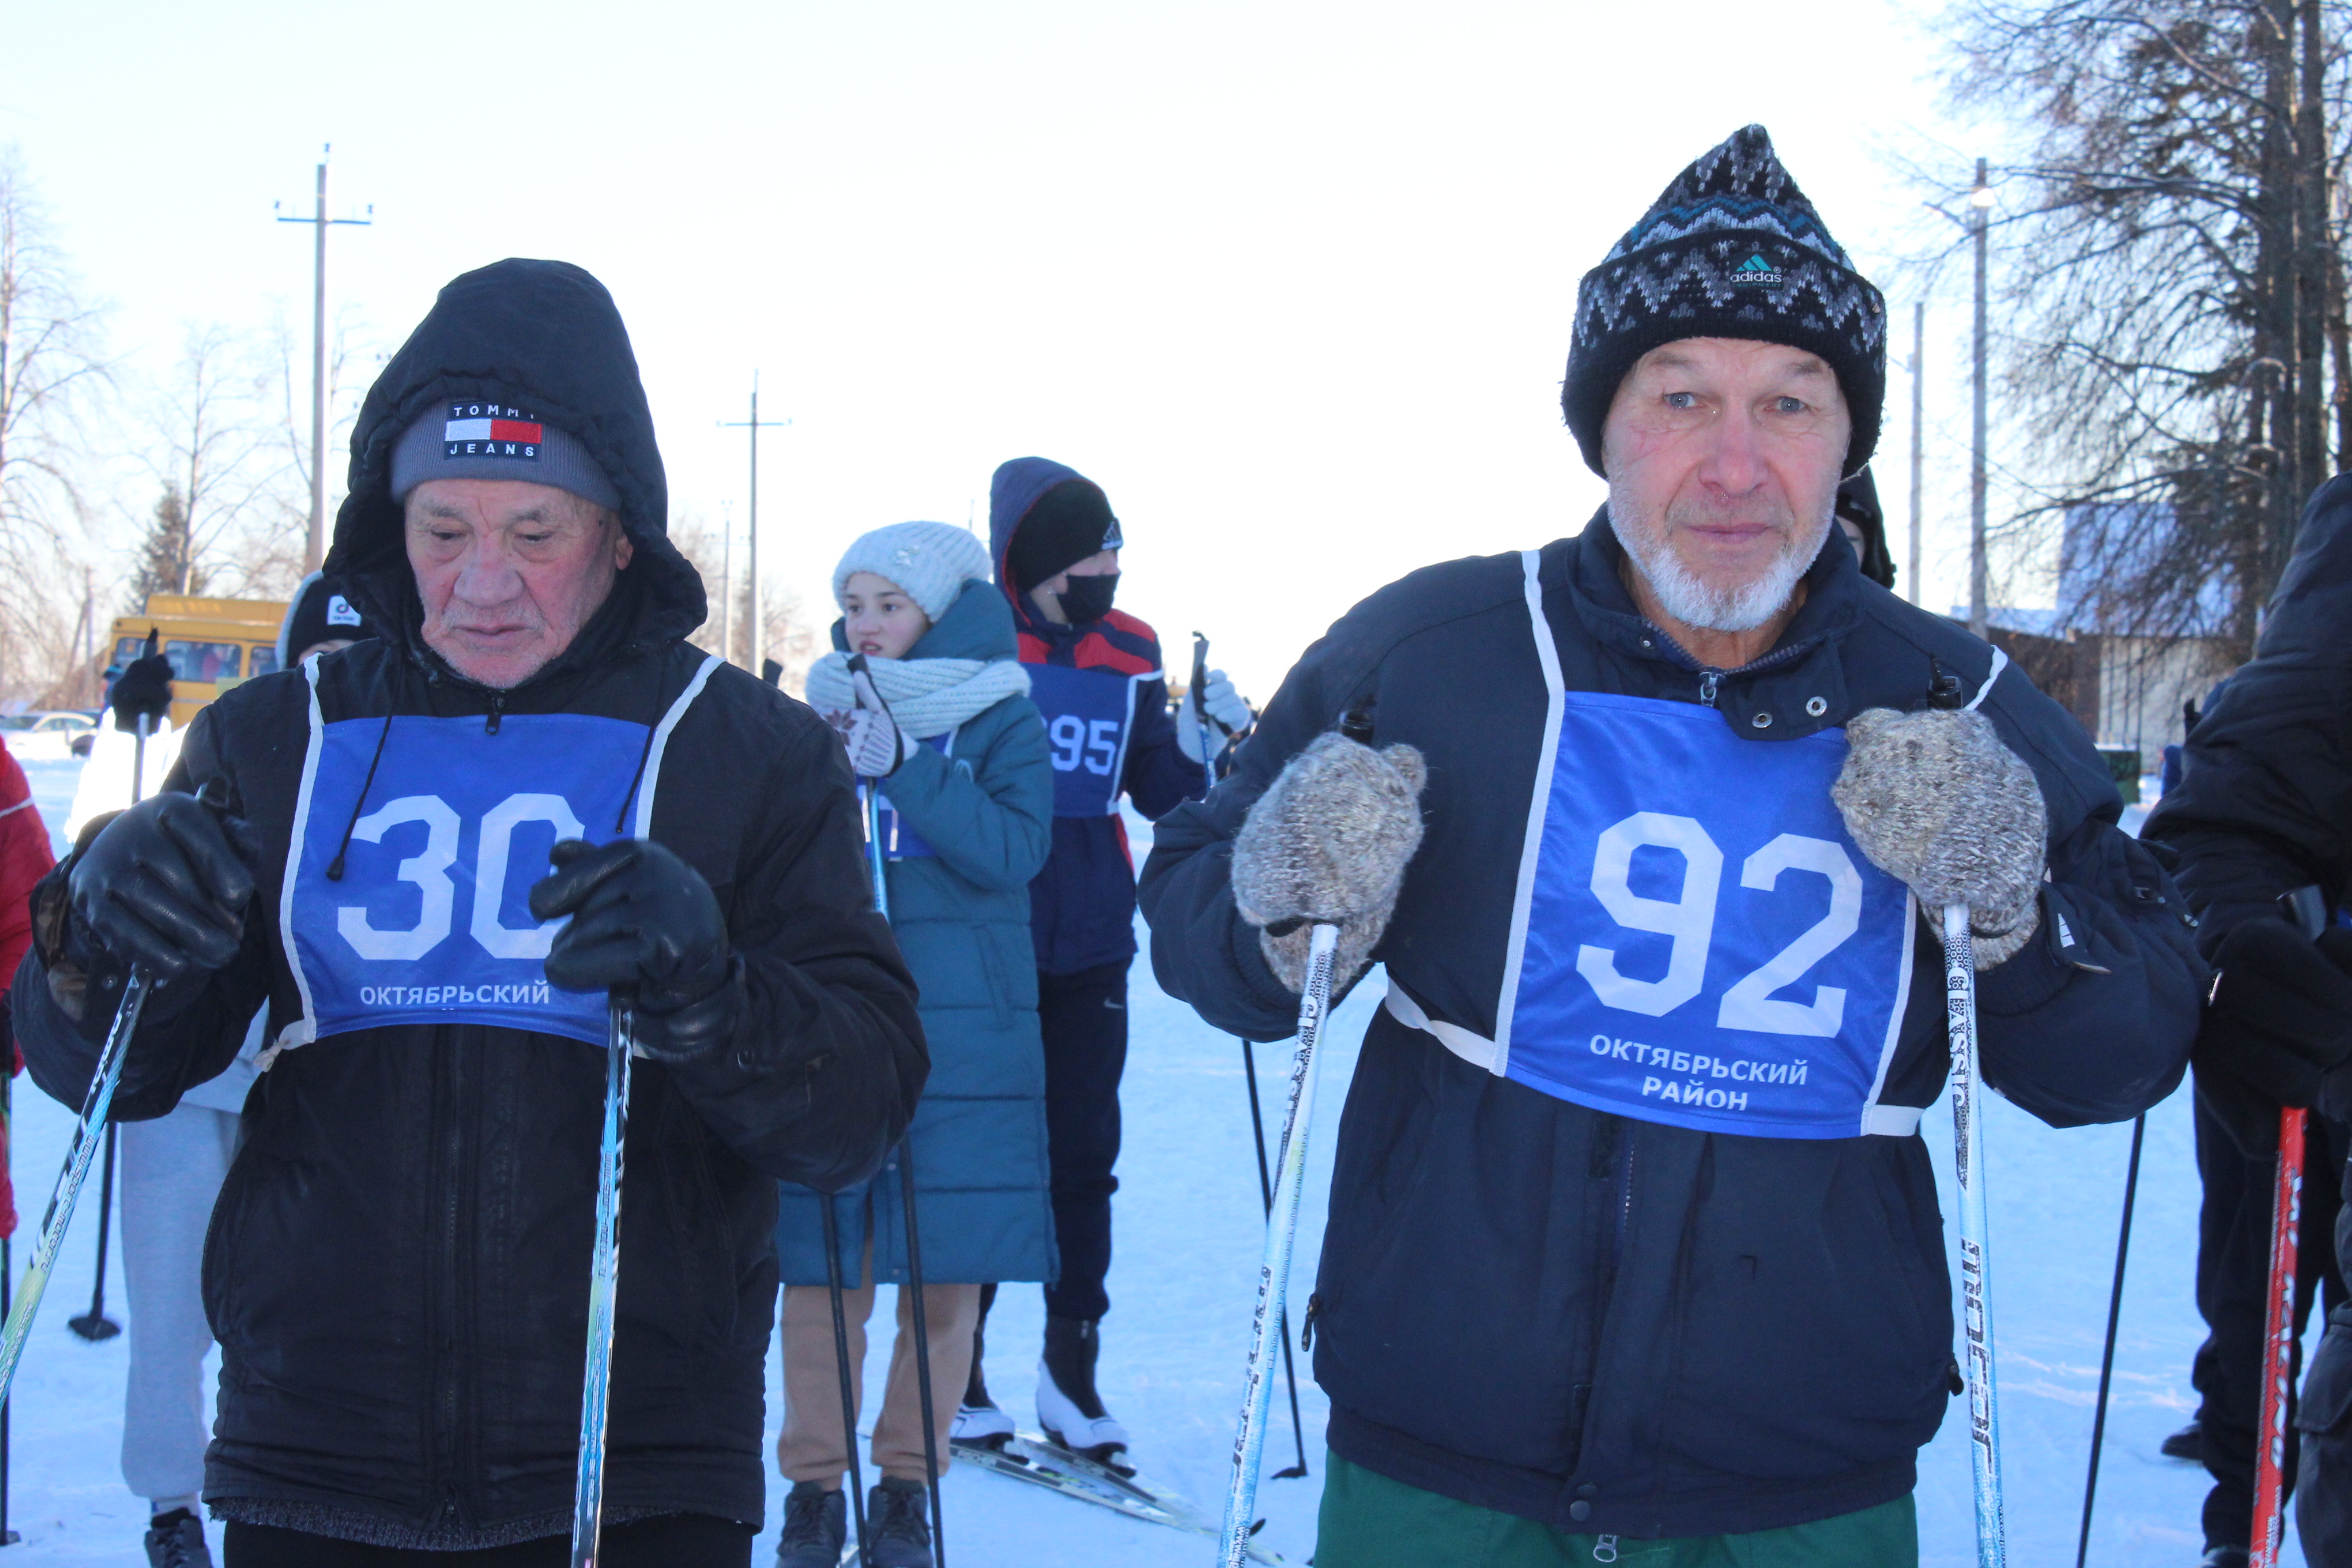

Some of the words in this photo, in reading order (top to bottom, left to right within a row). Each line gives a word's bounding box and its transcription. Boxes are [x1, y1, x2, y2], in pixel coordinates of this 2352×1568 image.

[1729, 271, 1782, 282] adidas
[450, 442, 535, 457] JEANS
[1041, 714, 1119, 777] 95
[336, 793, 585, 961] 30
[1575, 811, 1863, 1039] 92
[359, 979, 549, 1005] ОКТЯБРЬСКИЙ
[1589, 1034, 1808, 1085] ОКТЯБРЬСКИЙ
[1947, 966, 1971, 1108] CLASSIC
[1642, 1075, 1748, 1111] РАЙОН
[1960, 1236, 1994, 1476] motor
